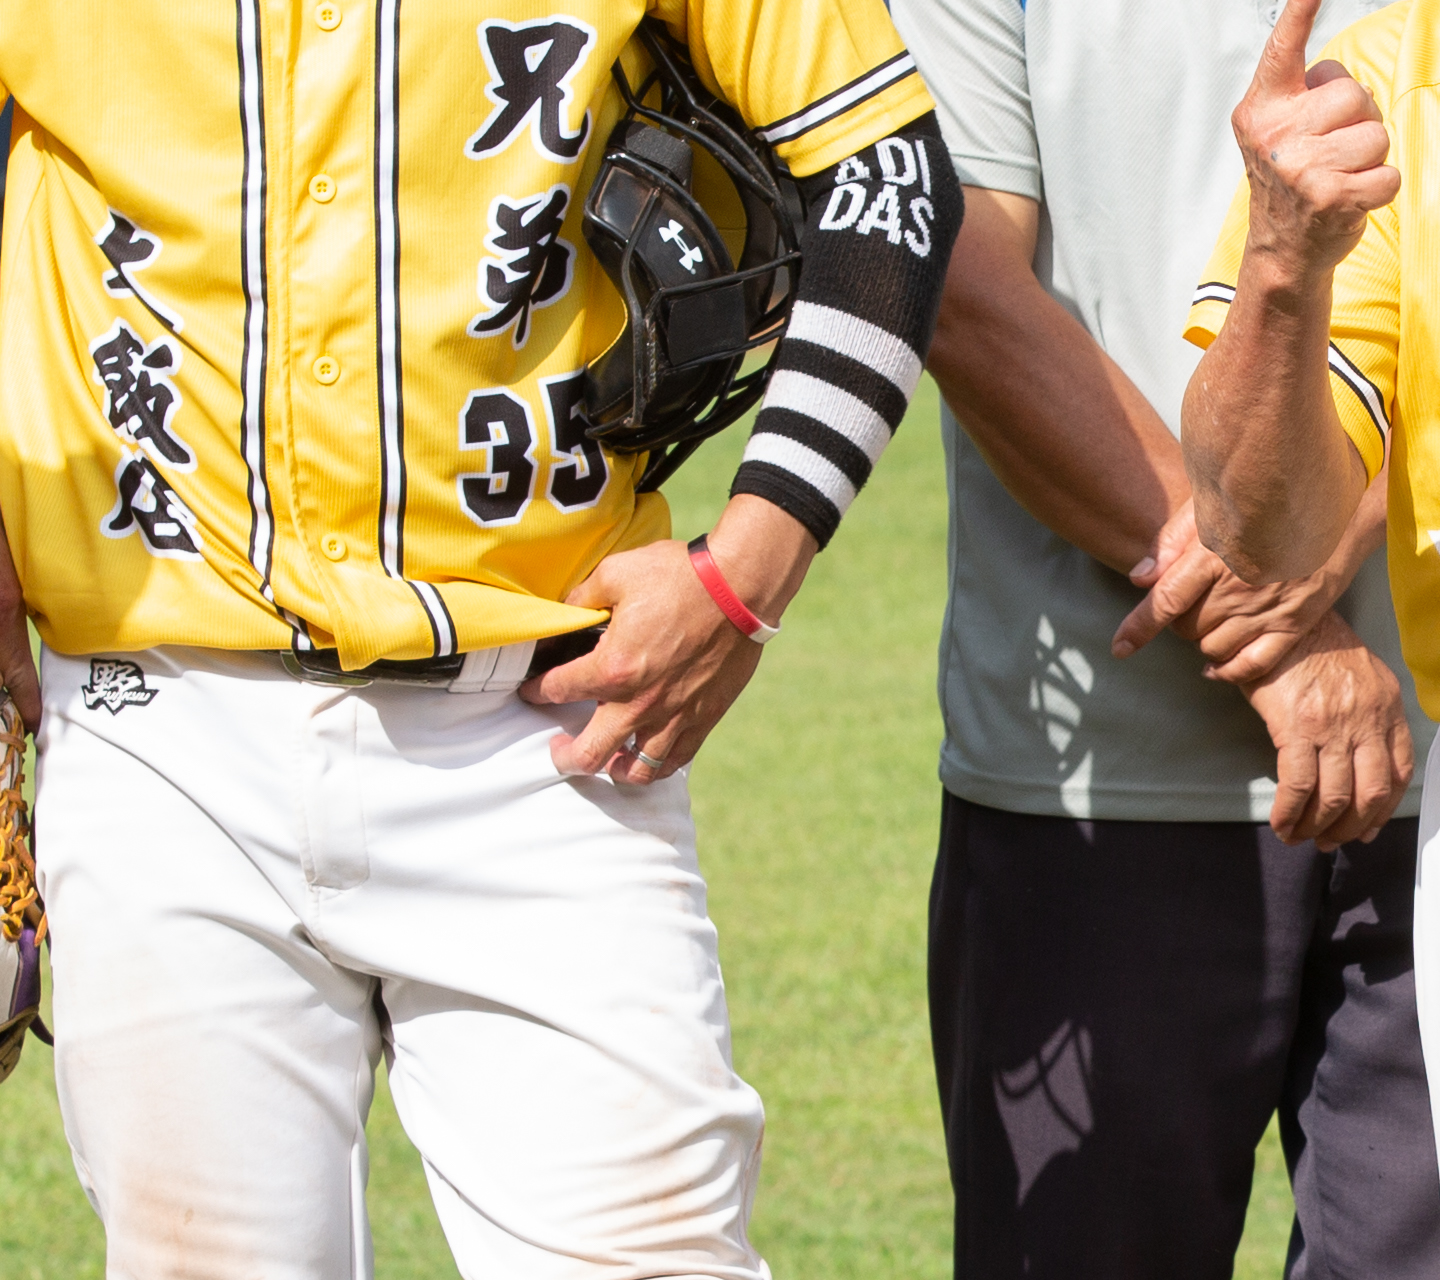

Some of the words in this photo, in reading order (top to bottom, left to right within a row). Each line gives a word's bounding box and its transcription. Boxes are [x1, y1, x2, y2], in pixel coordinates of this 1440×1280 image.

[468, 16, 595, 350] 兄弟
[819, 183, 934, 258] DAS
[457, 374, 609, 526] 35
